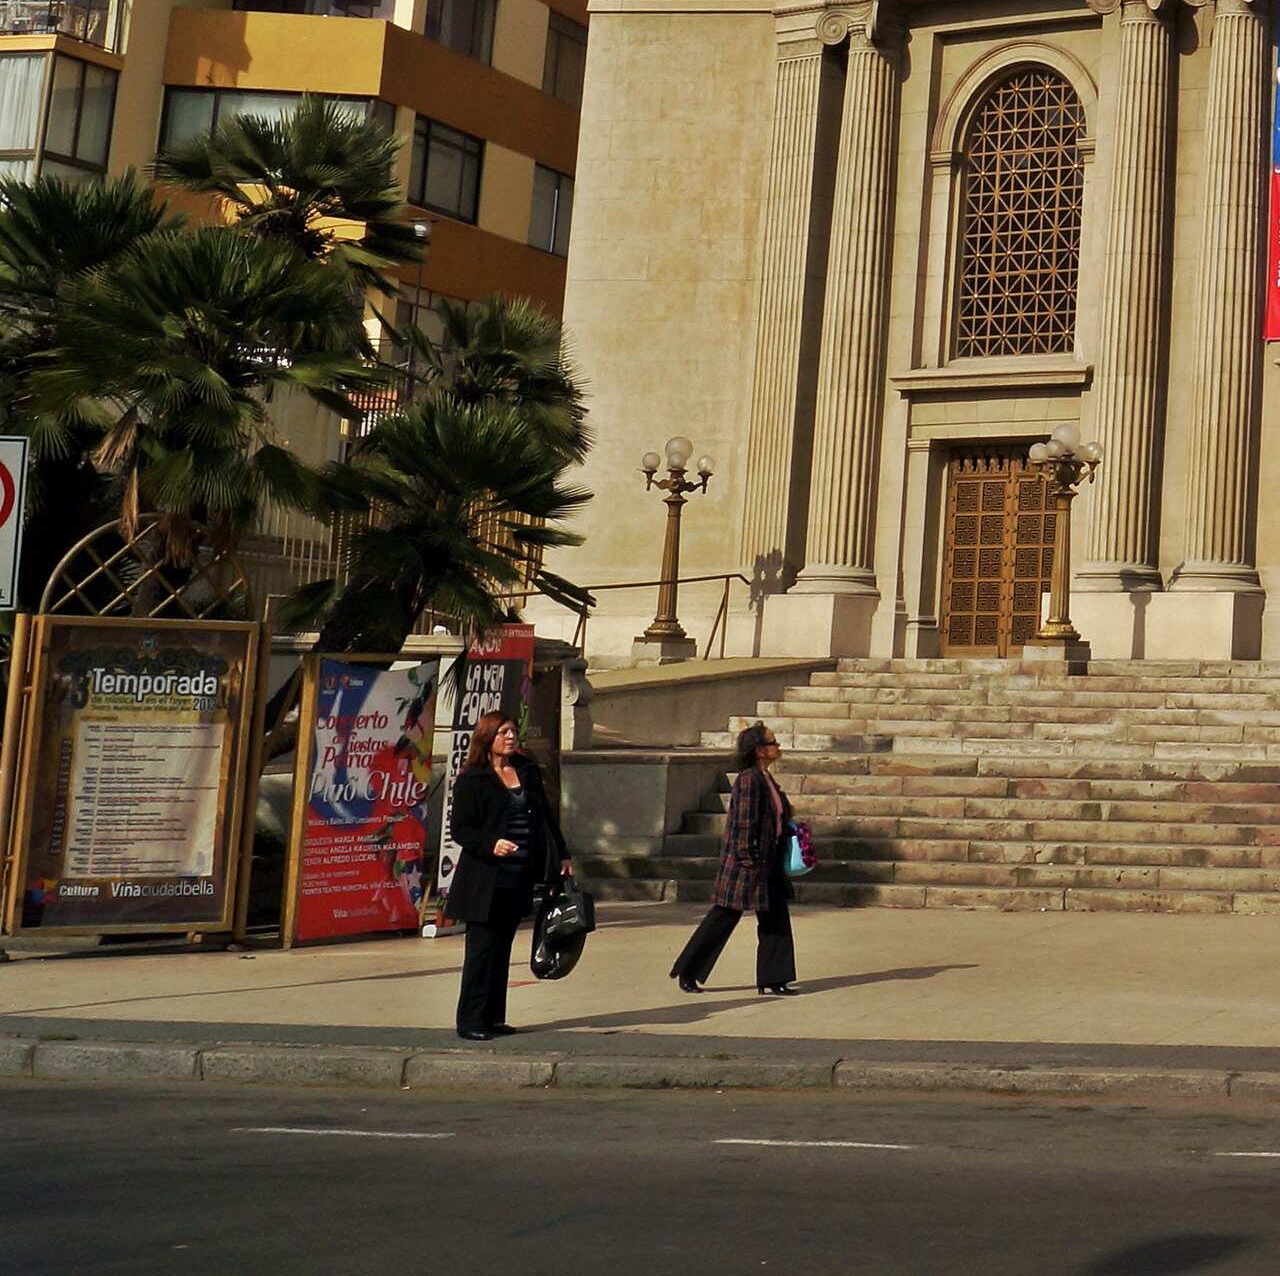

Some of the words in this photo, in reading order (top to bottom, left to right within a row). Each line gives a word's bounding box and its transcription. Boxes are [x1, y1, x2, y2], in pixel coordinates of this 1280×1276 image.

[93, 667, 218, 701] Temporada
[364, 770, 428, 807] Chile
[59, 884, 99, 897] Cultura
[110, 879, 215, 898] Viñaciudadbella
